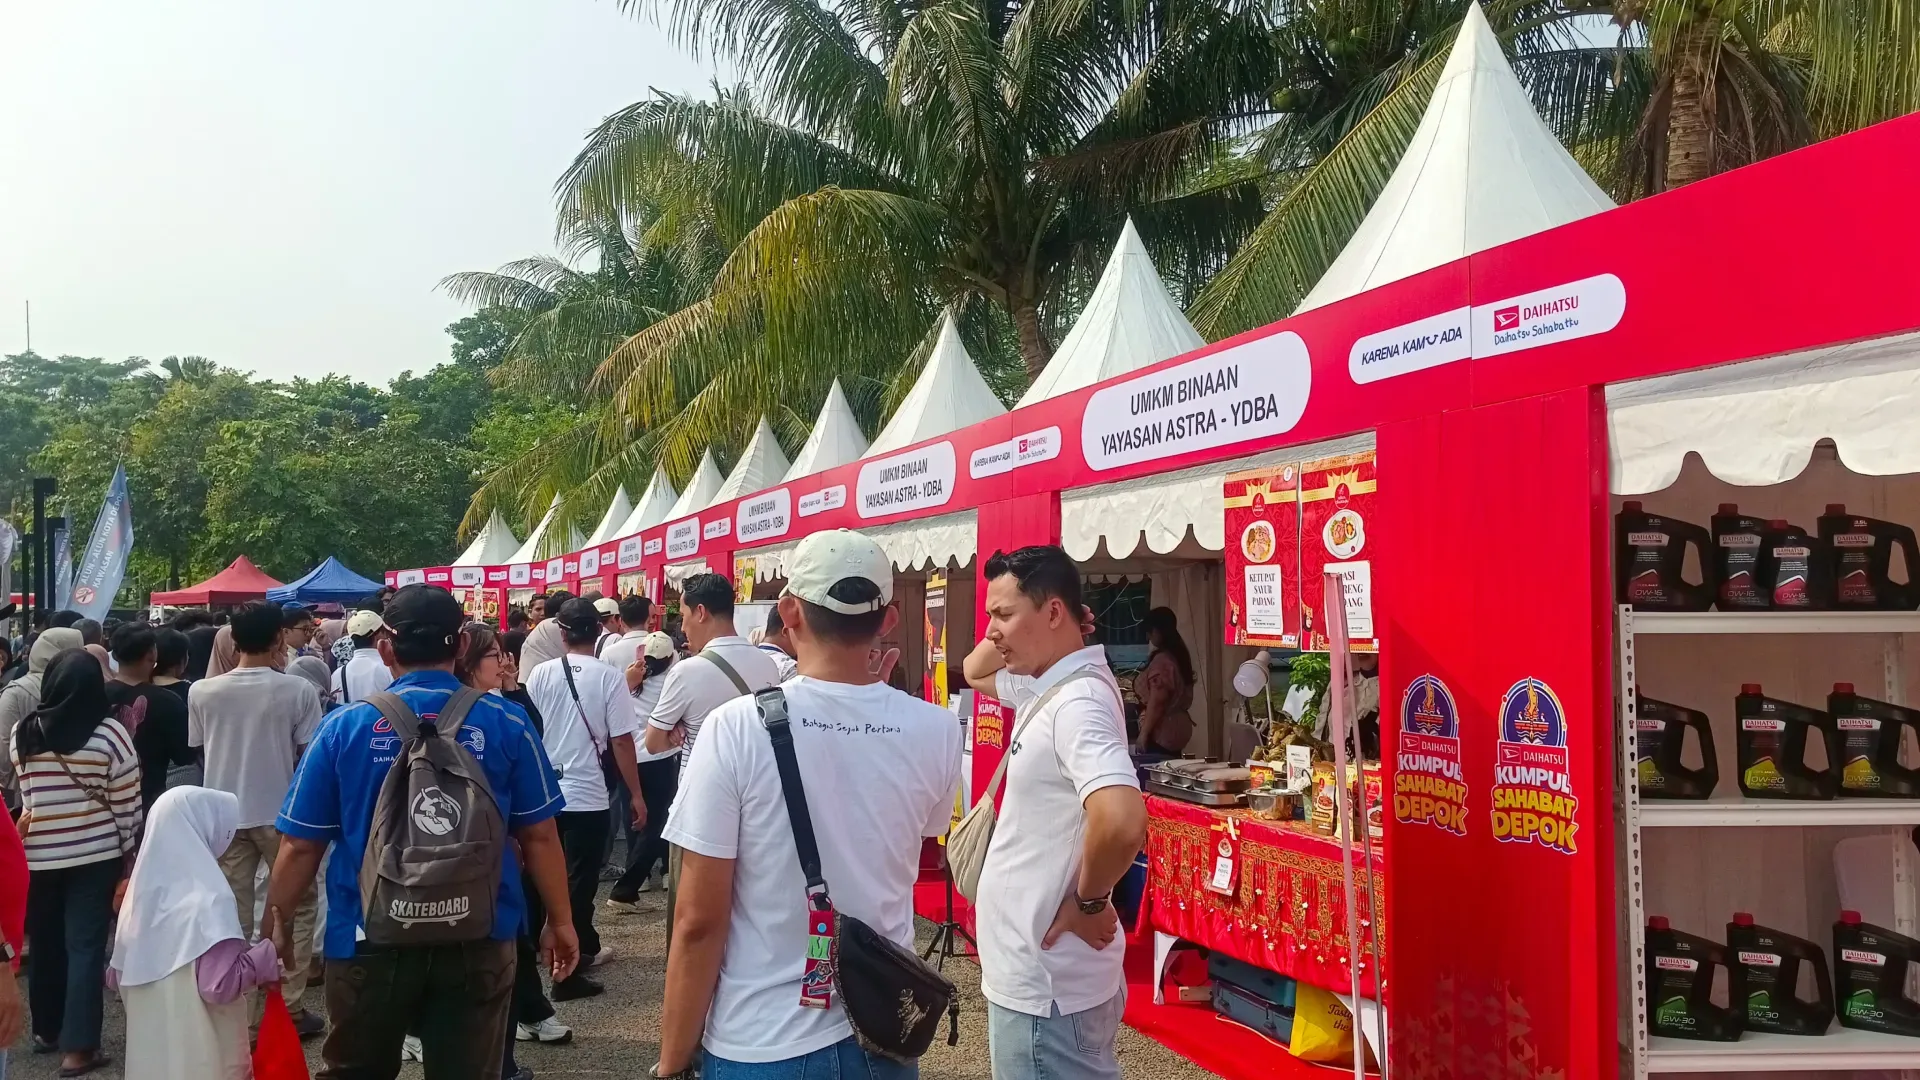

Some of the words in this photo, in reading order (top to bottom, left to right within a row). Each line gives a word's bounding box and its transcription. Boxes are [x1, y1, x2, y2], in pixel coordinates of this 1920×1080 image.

[1523, 295, 1579, 321] DAIHATSU
[1494, 328, 1531, 346] Daihatsu
[1361, 343, 1400, 366] KARENA
[1440, 327, 1462, 345] ADA
[1130, 383, 1174, 416] UMKM
[1177, 364, 1239, 404] BINAAN
[1101, 421, 1162, 456] YAYASAN
[1165, 408, 1218, 442] ASTRA
[1230, 393, 1279, 427] YDBA
[880, 463, 900, 484] UMKM
[900, 457, 928, 479] BINAAN
[865, 487, 894, 509] YAYASAN
[894, 484, 917, 504] ASTRA
[922, 478, 943, 497] YDBA
[93, 536, 106, 559] ALUN
[103, 516, 115, 538] KOTA
[92, 550, 114, 588] KAWASAN
[1249, 573, 1275, 583] KETUPAT
[1343, 570, 1355, 581] ASI
[1254, 585, 1272, 594] SAYUR
[1343, 583, 1363, 594] RENG
[1252, 597, 1275, 606] PADANG
[802, 717, 833, 731] Bahagia
[977, 715, 1003, 730] SAHABAT
[977, 728, 1003, 748] DEPOK
[1421, 739, 1457, 755] DAIHATSU
[1523, 751, 1564, 765] DAIHATSU
[1398, 754, 1461, 781] KUMPUL
[1496, 765, 1570, 794] KUMPUL
[1751, 776, 1785, 784] 0W-20
[1396, 774, 1466, 804] SAHABAT
[1494, 788, 1576, 819] SAHABAT
[1395, 795, 1468, 832] DEPOK
[1492, 810, 1578, 851] DEPOK
[389, 896, 469, 917] SKATEBOARD
[1658, 957, 1691, 966] DAIHATSU
[1741, 952, 1774, 961] DAIHATSU
[1844, 950, 1878, 960] DAIHATSU
[1662, 1015, 1696, 1025] 5W-30
[1850, 1007, 1884, 1018] 5W-30
[1333, 1019, 1349, 1031] the
